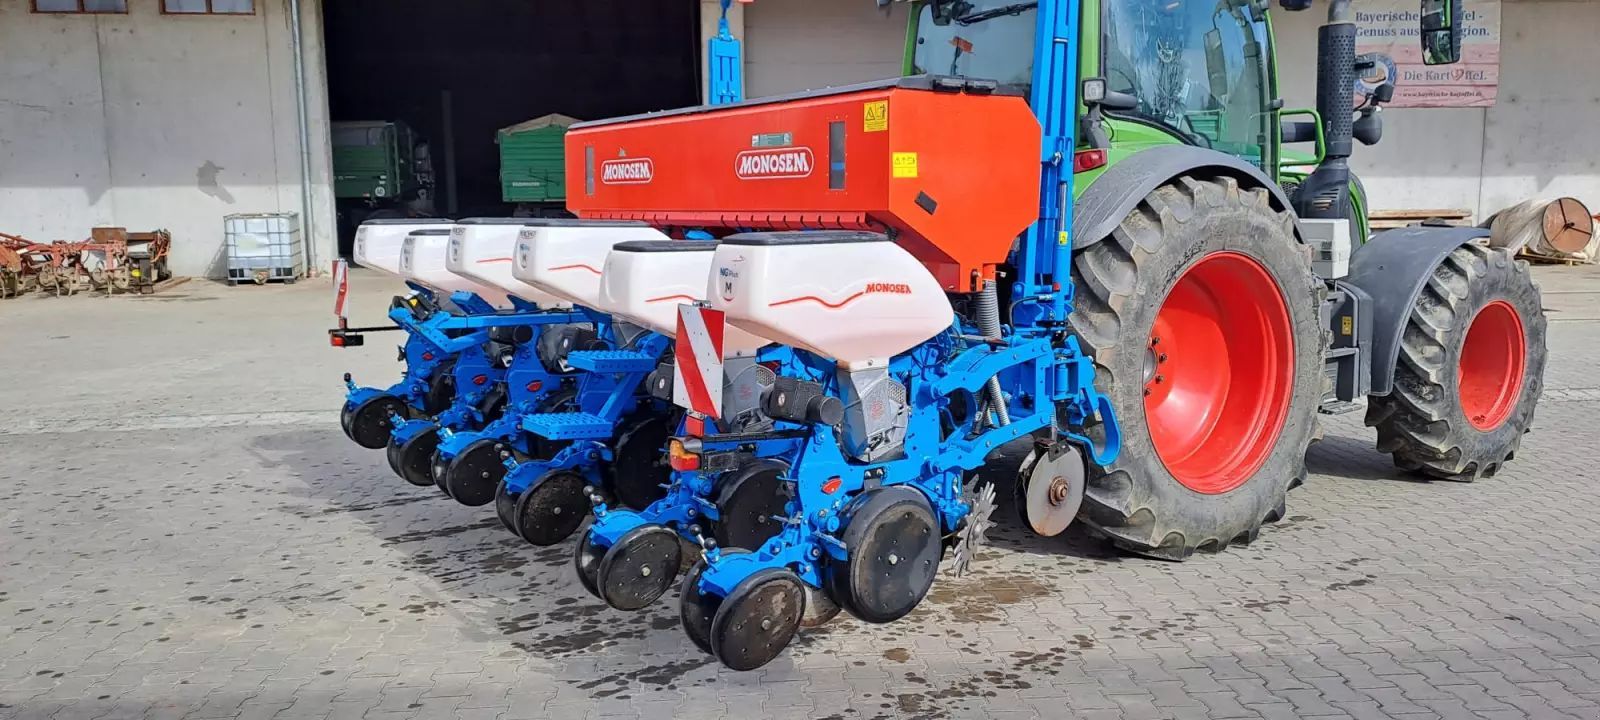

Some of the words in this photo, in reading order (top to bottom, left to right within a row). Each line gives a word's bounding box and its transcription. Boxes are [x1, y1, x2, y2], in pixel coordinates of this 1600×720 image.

[1356, 11, 1419, 24] Bayerische
[1356, 27, 1397, 36] Genuss
[1400, 28, 1420, 36] aus
[1404, 71, 1423, 81] Die
[739, 152, 809, 175] MONOSEM
[603, 162, 651, 180] MONOSEM
[725, 281, 732, 294] M
